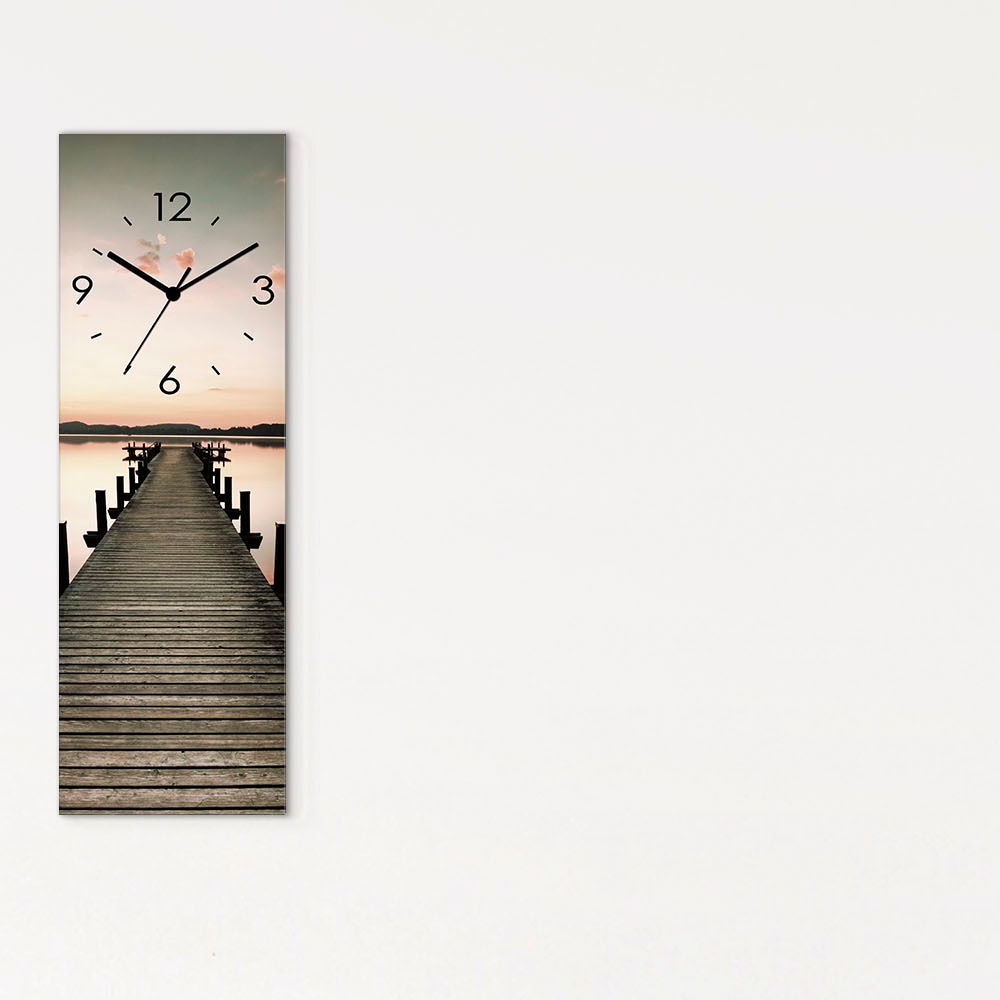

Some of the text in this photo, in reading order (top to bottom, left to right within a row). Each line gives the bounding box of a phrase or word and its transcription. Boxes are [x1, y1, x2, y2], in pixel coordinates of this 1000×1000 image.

[153, 191, 192, 222] 12
[72, 275, 94, 305] 9
[251, 275, 275, 306] 3
[159, 365, 181, 395] 6
